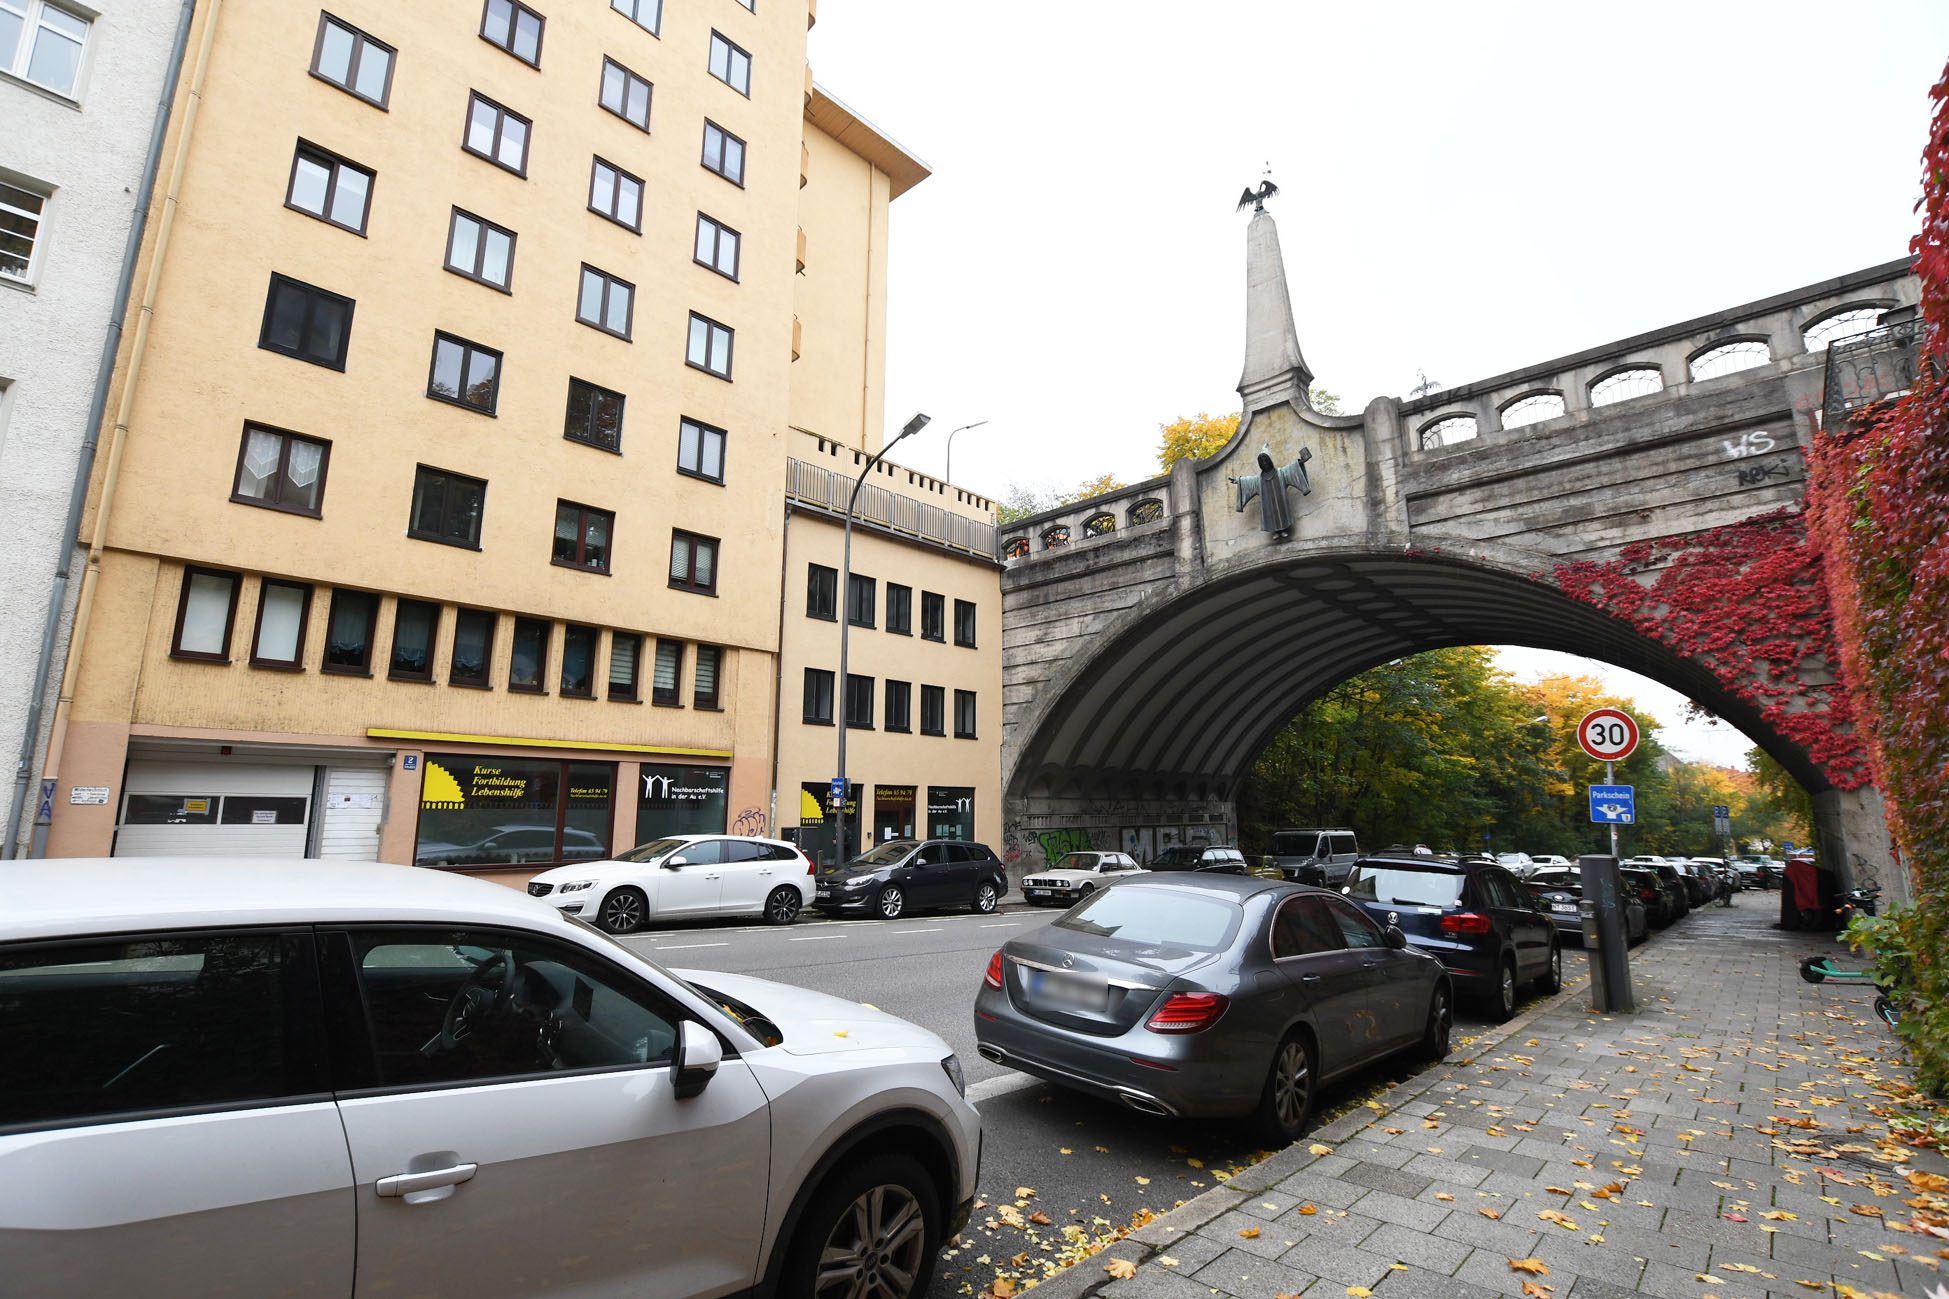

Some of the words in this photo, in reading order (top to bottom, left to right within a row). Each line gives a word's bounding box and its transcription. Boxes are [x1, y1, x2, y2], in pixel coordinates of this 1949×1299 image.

[1591, 723, 1625, 746] 30
[408, 756, 414, 764] 2
[473, 765, 502, 775] Kurse
[472, 776, 527, 788] Fortbildung
[471, 787, 525, 799] Lebenshilfe
[1592, 790, 1630, 799] Parkschein
